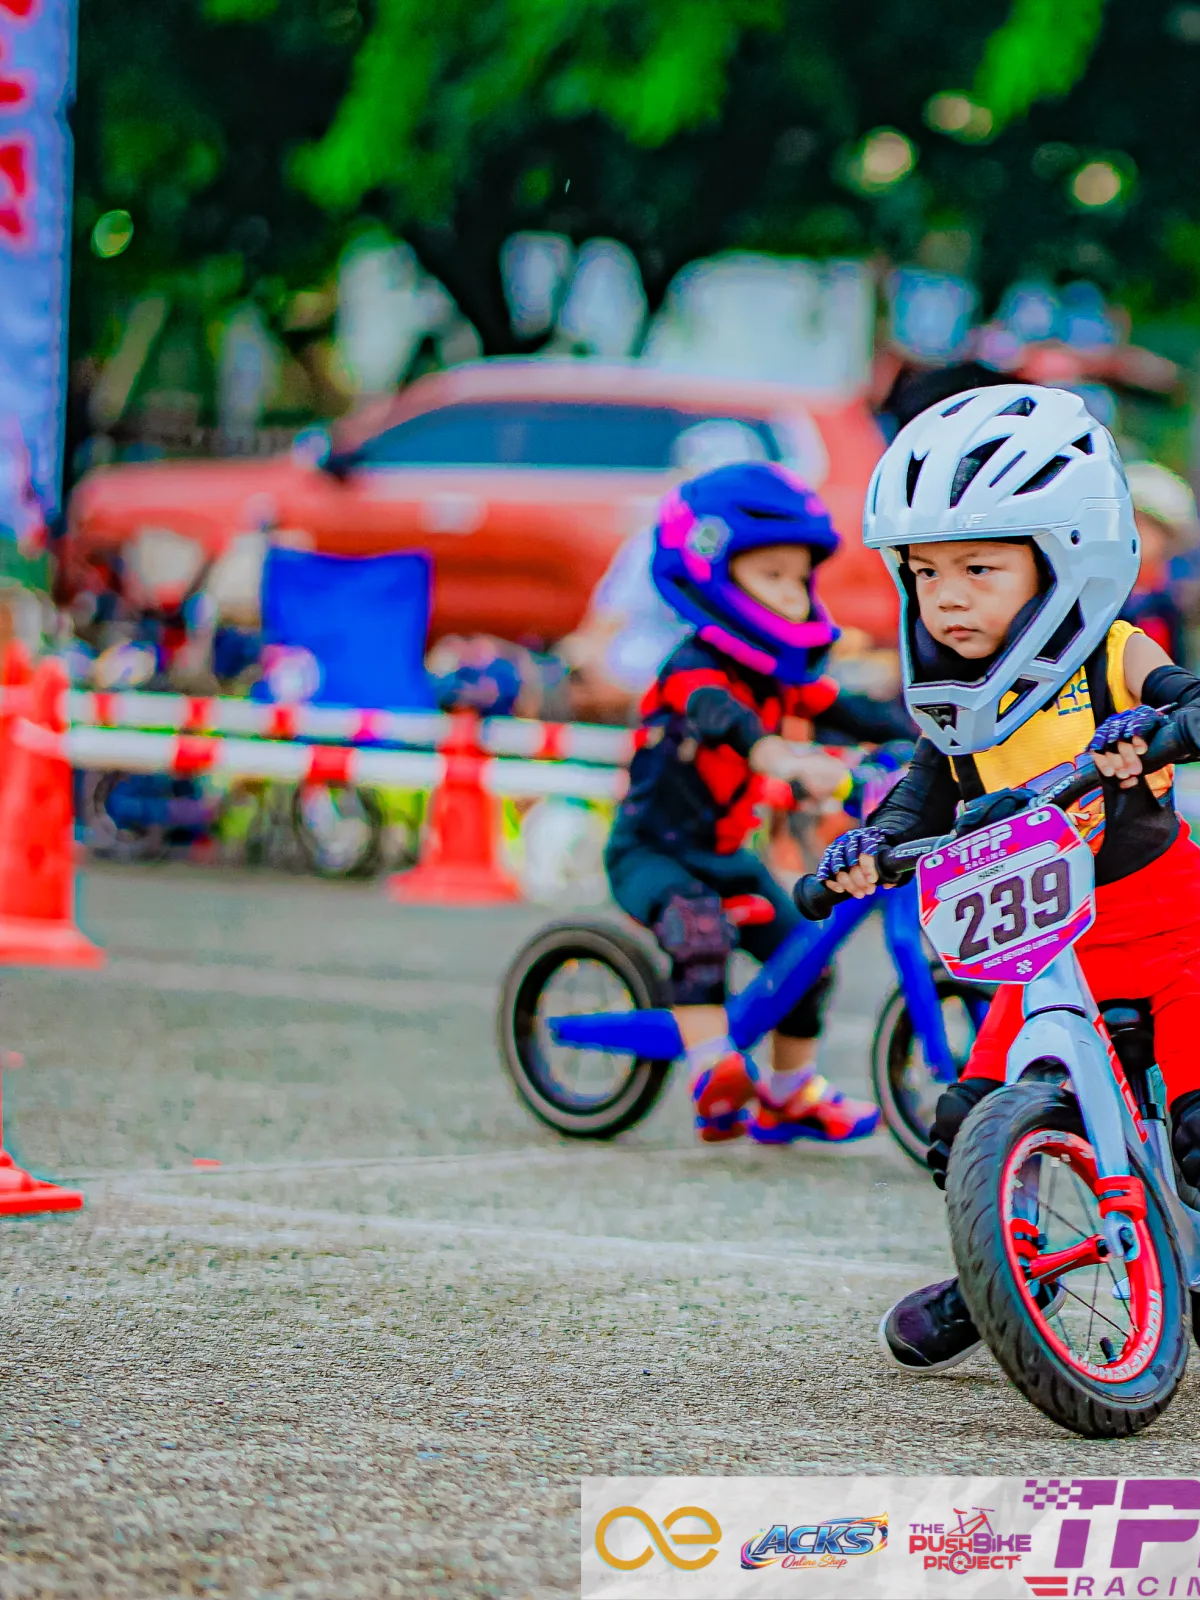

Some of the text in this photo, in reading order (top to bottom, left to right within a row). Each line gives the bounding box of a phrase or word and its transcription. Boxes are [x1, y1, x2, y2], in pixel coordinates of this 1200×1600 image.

[948, 824, 1013, 864] TPP
[964, 849, 1007, 871] RACING
[955, 858, 1072, 962] 239
